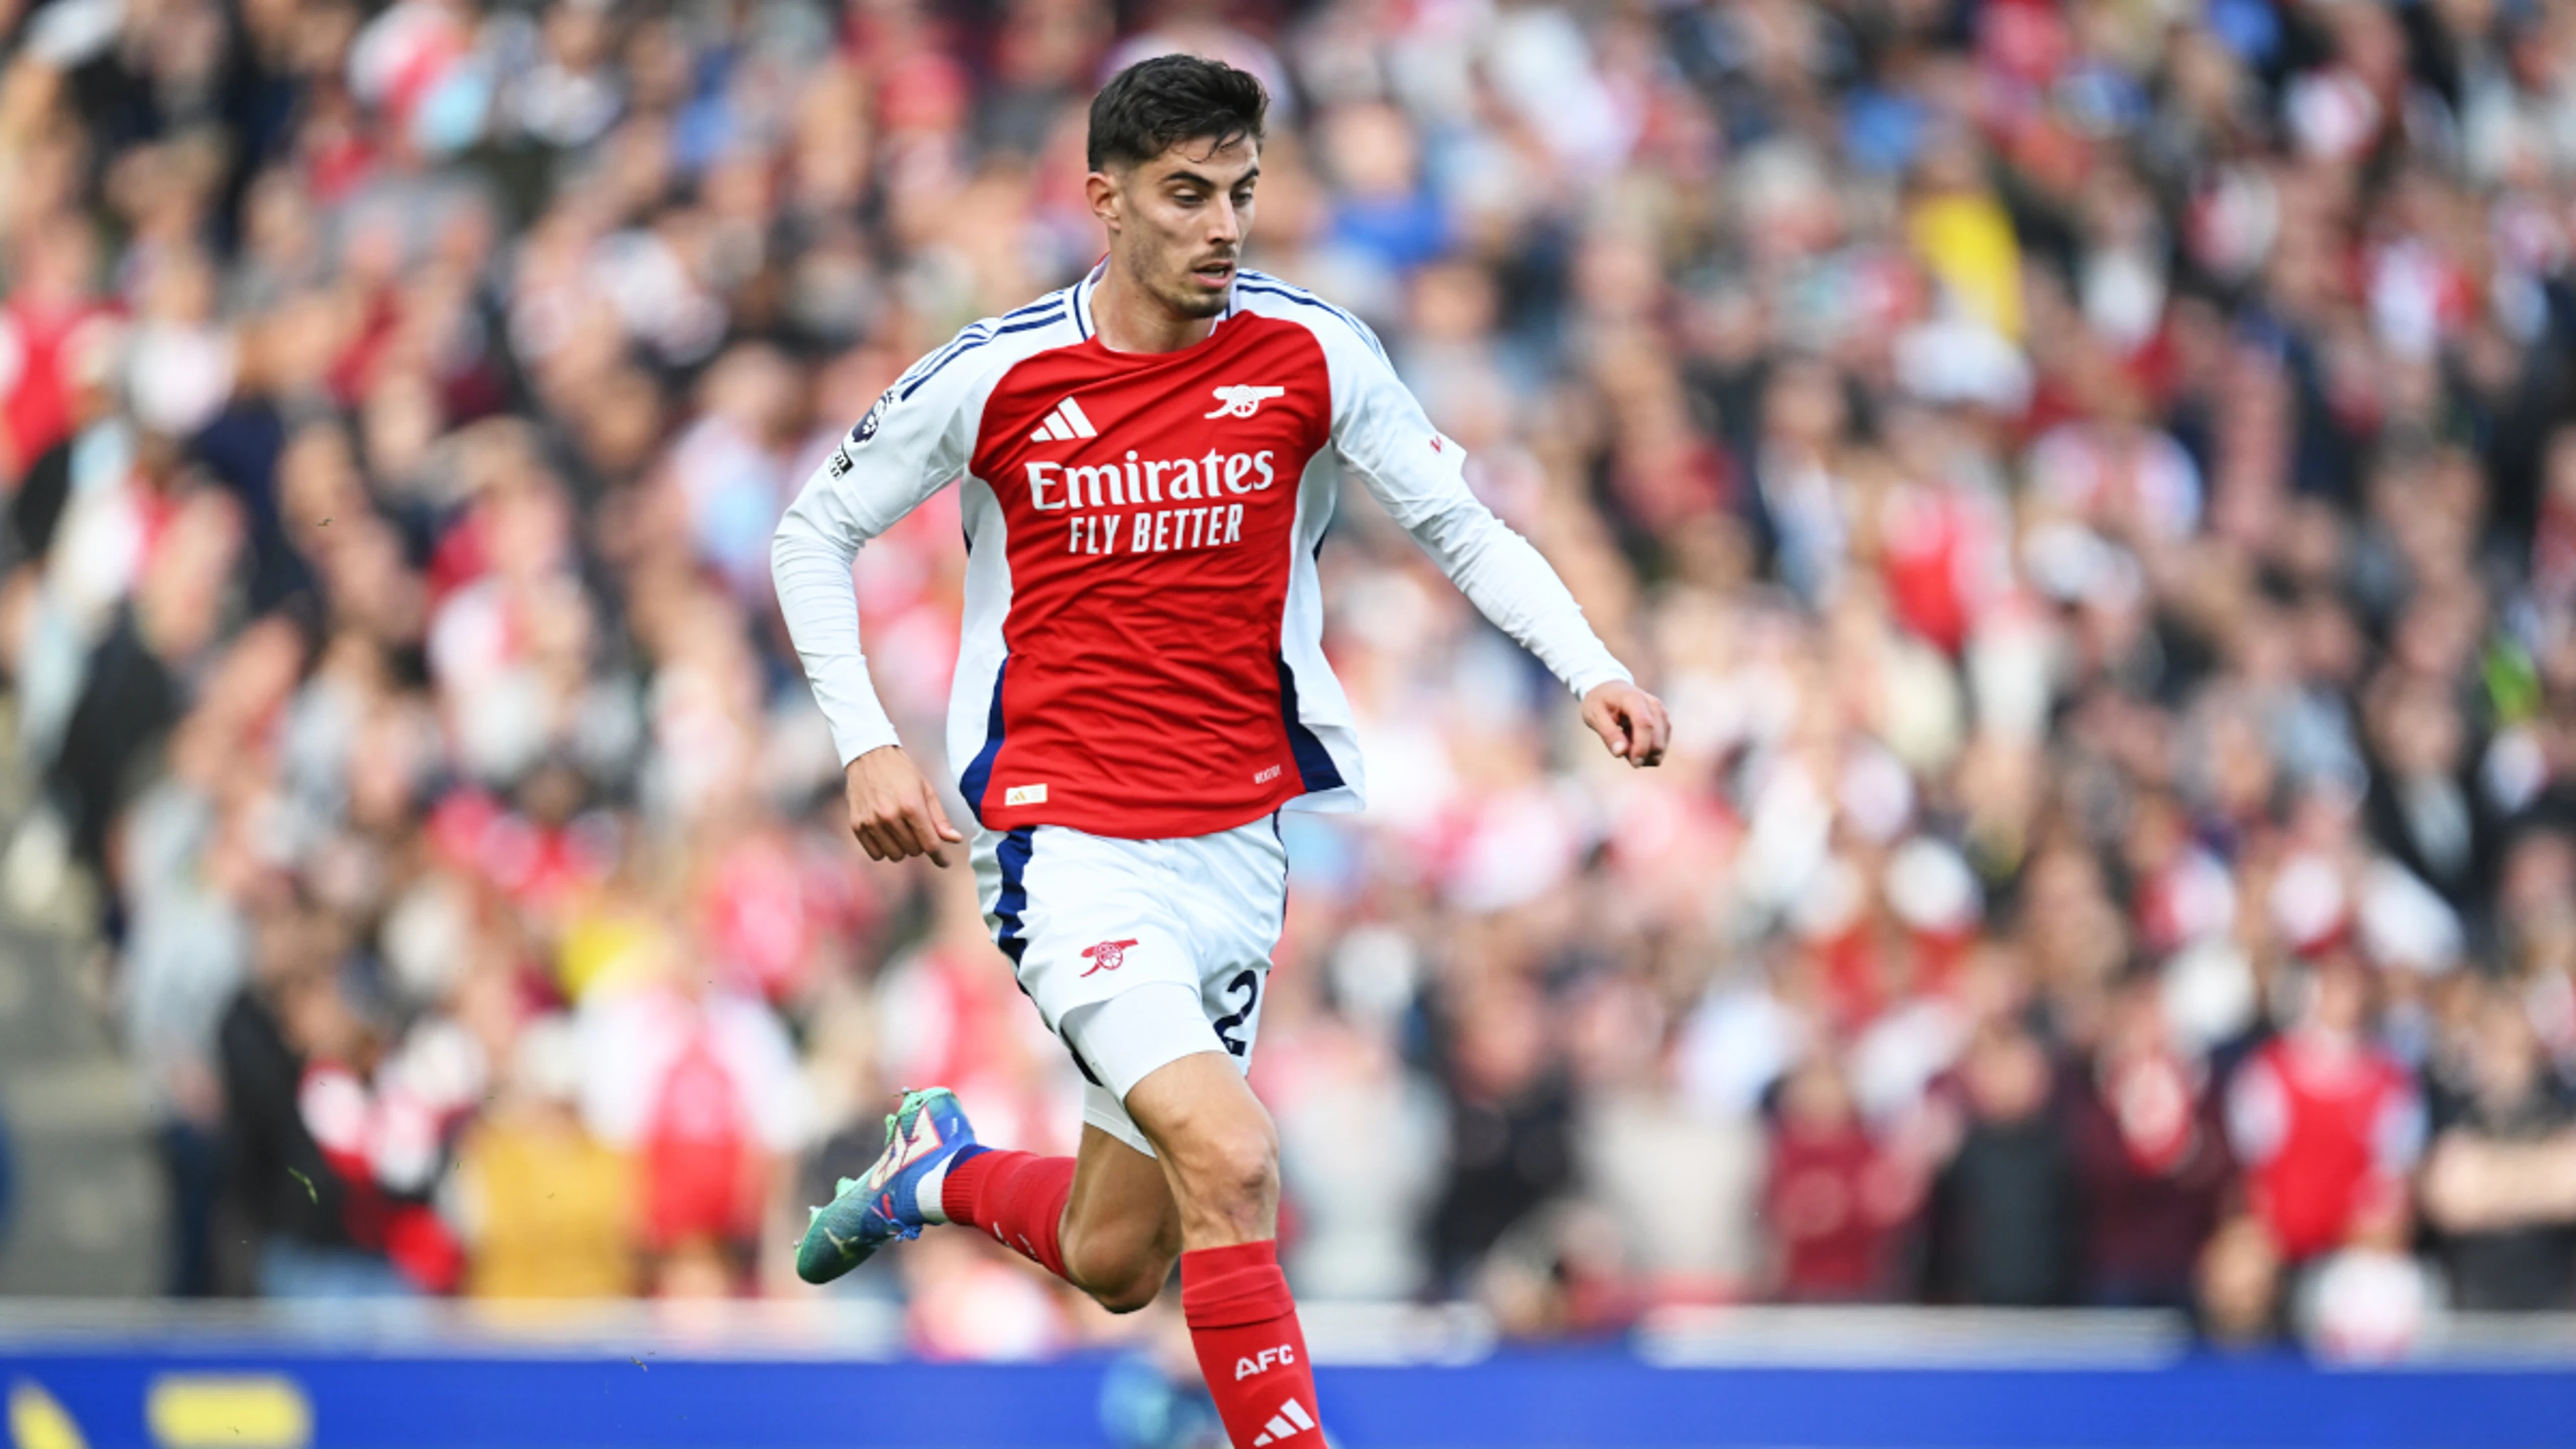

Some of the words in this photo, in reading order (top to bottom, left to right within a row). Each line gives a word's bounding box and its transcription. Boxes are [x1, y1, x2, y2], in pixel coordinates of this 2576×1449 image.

[1024, 447, 1274, 511] Emirates
[1069, 515, 1121, 554] FLY
[1131, 504, 1244, 553] BETTER
[1213, 969, 1258, 1057] 2
[1234, 1344, 1294, 1381] AFC
